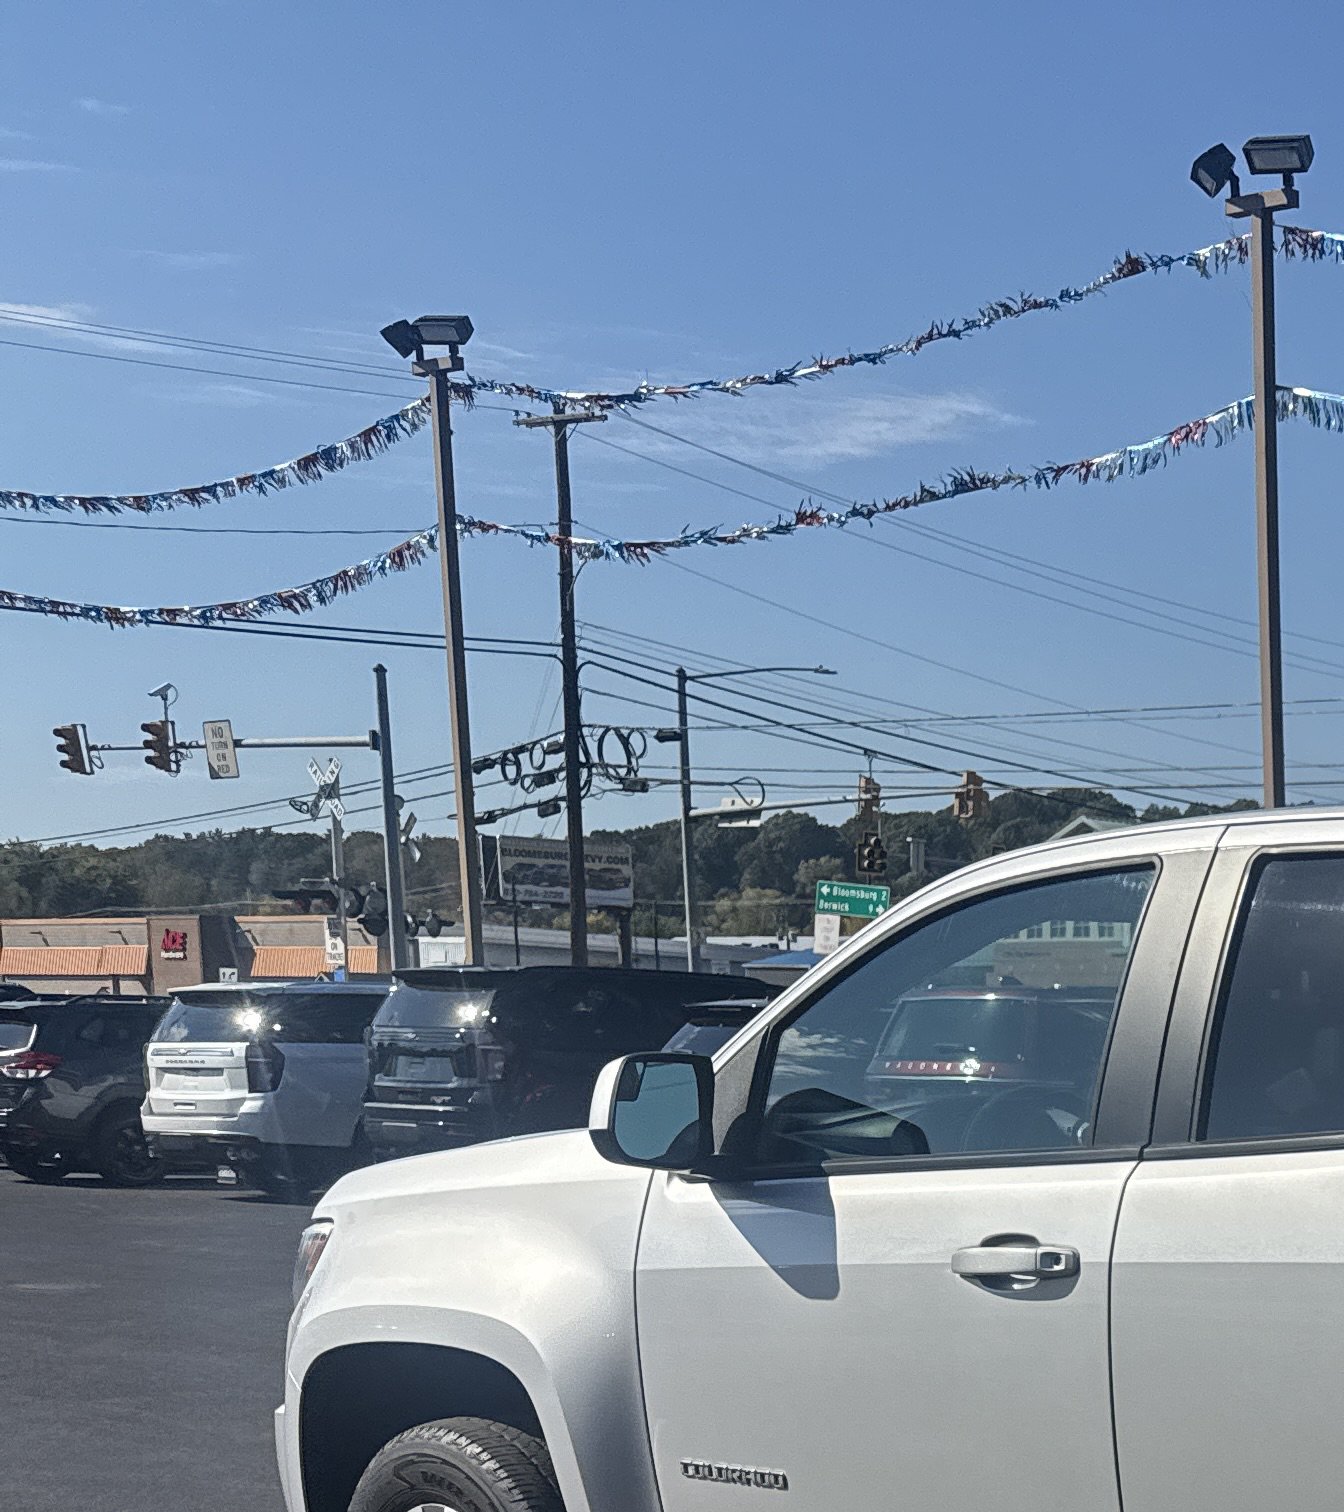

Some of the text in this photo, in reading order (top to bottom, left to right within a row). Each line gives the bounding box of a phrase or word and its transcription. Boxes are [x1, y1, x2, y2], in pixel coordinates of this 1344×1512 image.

[211, 726, 224, 739] NO
[211, 740, 229, 751] TURN
[216, 752, 227, 762] ON
[217, 764, 231, 774] RED
[832, 886, 887, 901] Bloomsburg 2
[819, 898, 850, 912] Berwick
[160, 928, 185, 950] ACE
